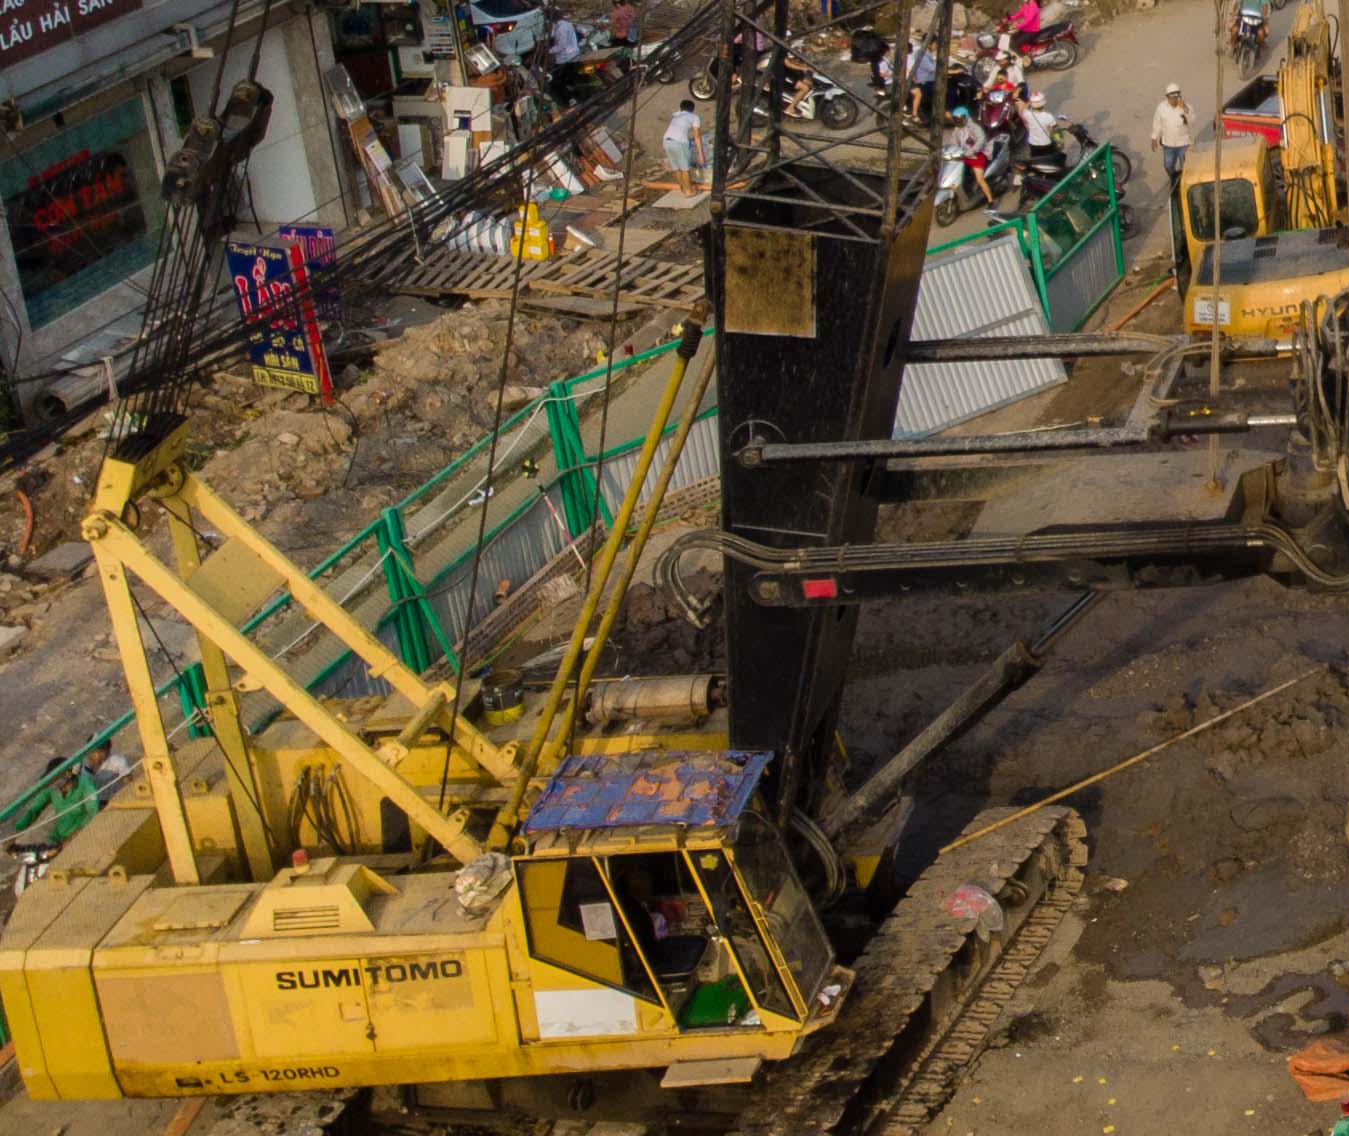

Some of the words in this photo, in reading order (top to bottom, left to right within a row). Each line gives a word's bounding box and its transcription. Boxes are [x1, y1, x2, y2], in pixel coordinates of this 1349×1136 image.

[39, 1, 70, 35] HẢI
[1241, 303, 1299, 318] HYUN
[275, 958, 463, 991] SUMITOMO
